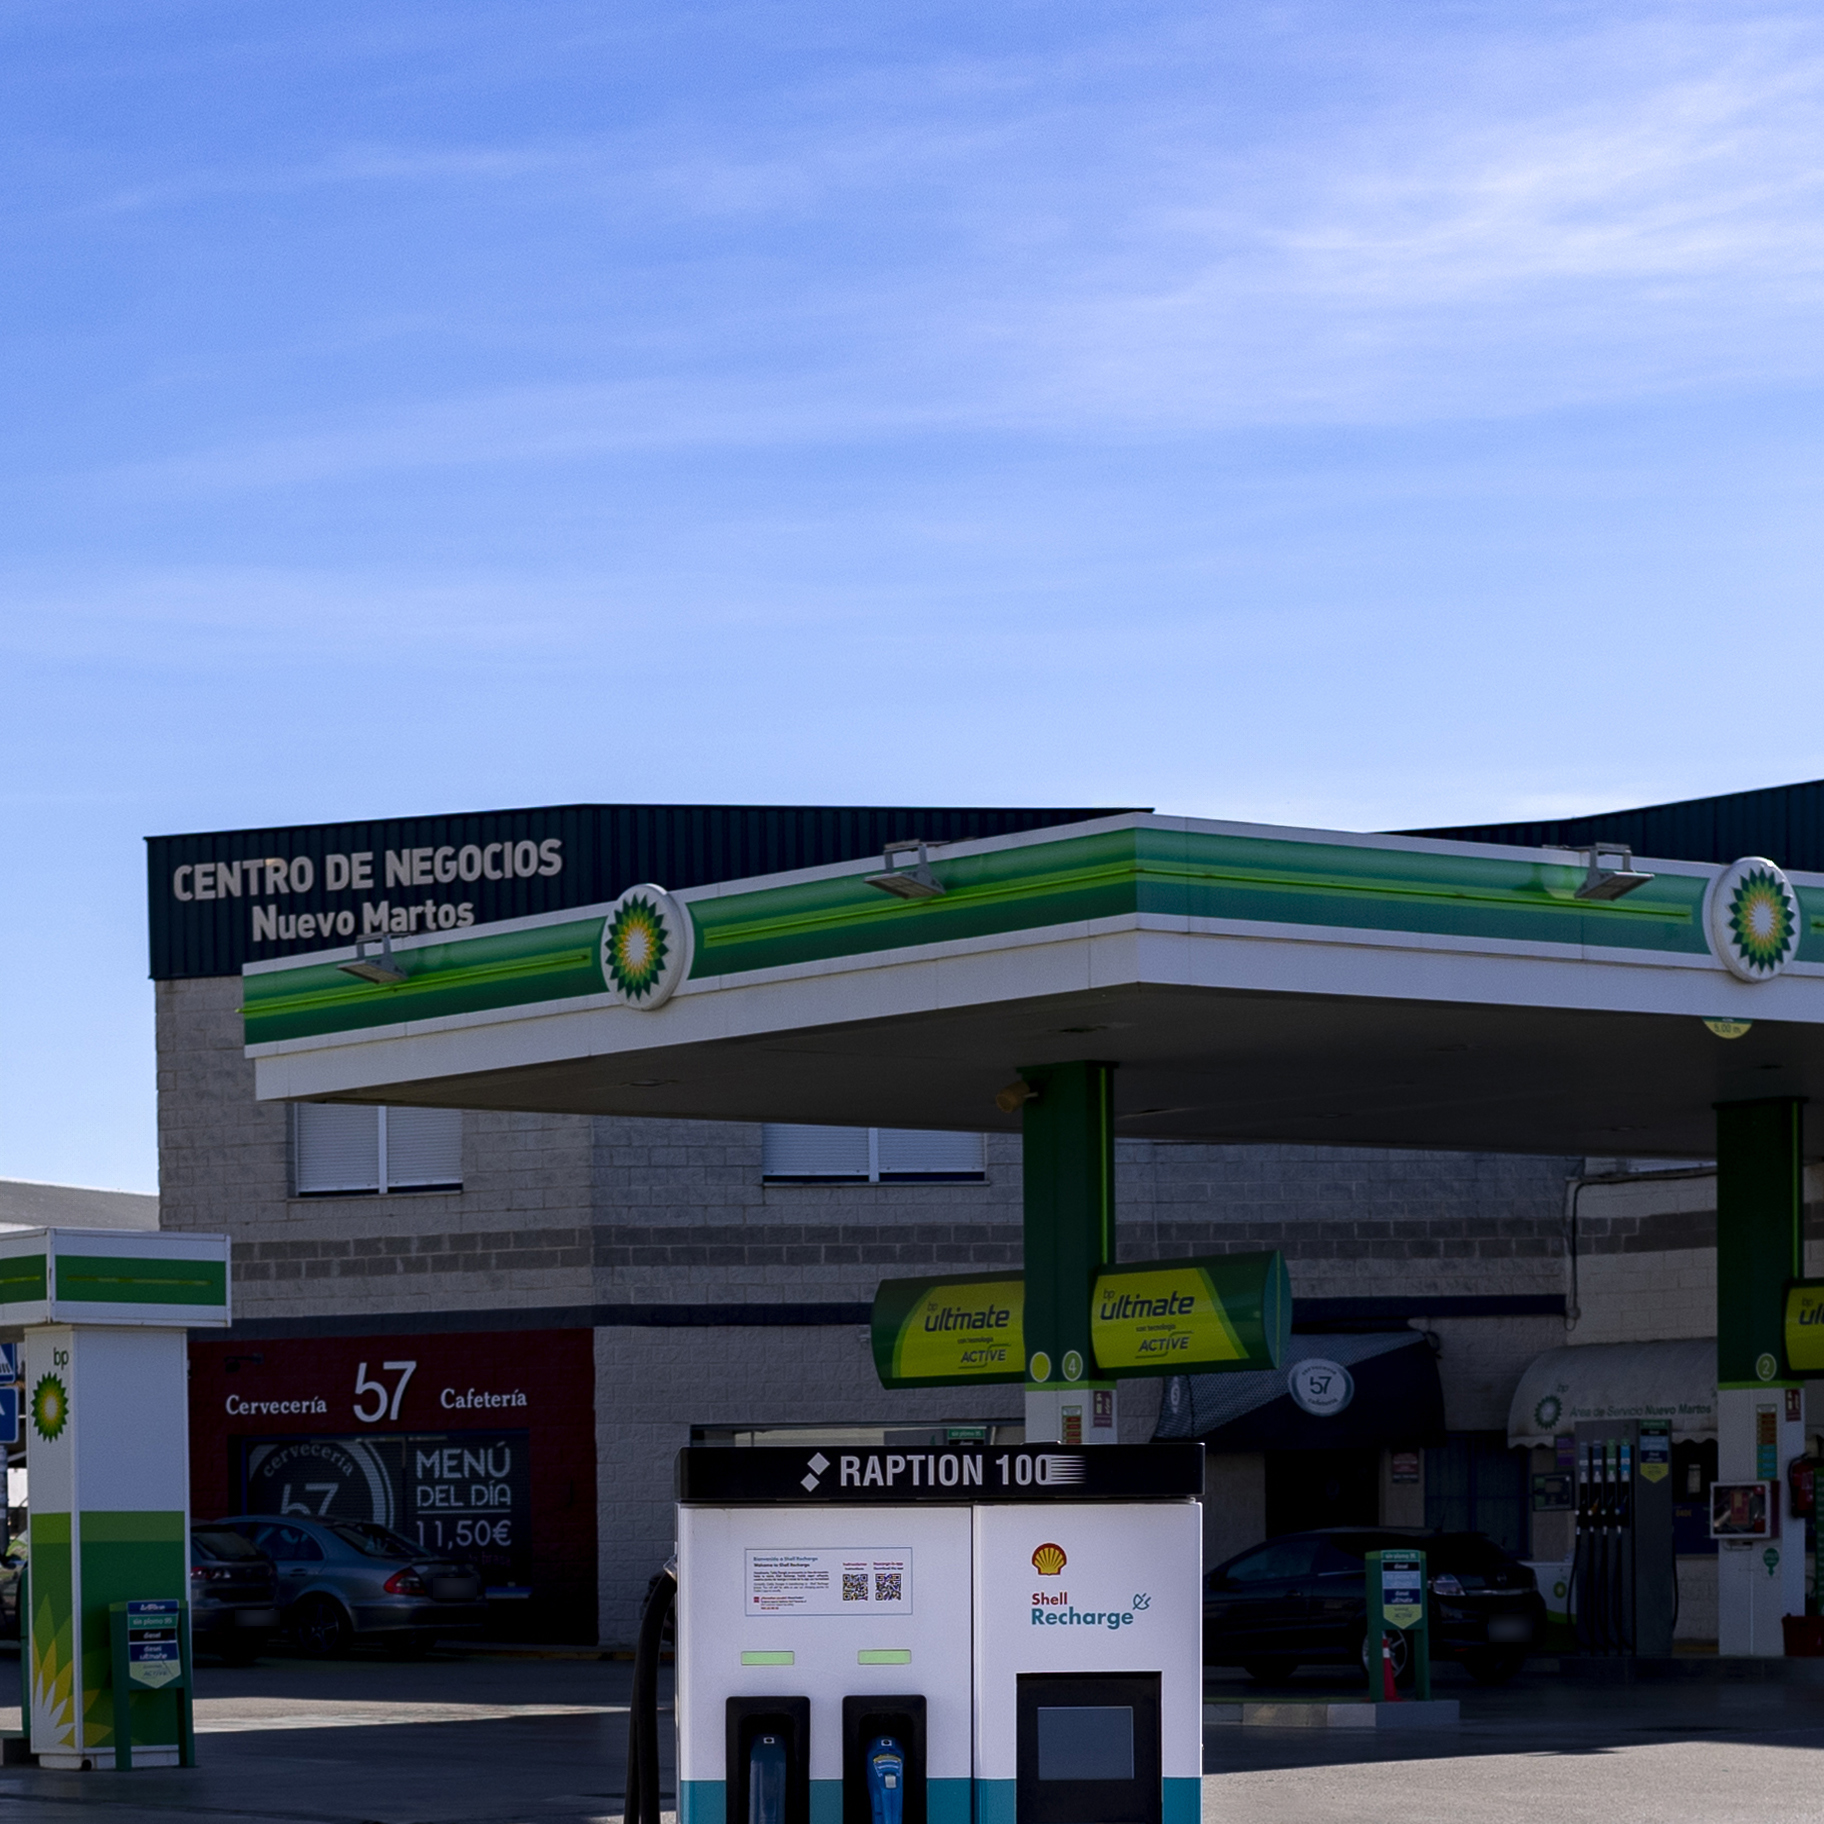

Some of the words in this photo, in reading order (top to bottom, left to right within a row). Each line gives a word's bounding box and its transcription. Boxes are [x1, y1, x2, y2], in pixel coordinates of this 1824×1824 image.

[173, 856, 314, 901] CENTRO
[325, 852, 374, 891] DE
[385, 838, 563, 888] NEGOCIOS
[251, 903, 355, 942] Nuevo
[363, 899, 475, 935] Martos
[925, 1304, 1010, 1332] ultimate
[1100, 1291, 1195, 1321] ultimate
[960, 1347, 1006, 1364] ACTIVE
[1139, 1335, 1190, 1352] ACTIVE
[53, 1347, 70, 1370] bp
[1068, 1357, 1076, 1372] 4
[1762, 1359, 1770, 1372] 2
[353, 1360, 417, 1423] 57
[1310, 1376, 1331, 1395] 57
[226, 1394, 327, 1416] Cervecería
[440, 1388, 527, 1409] Cafetería
[1593, 1407, 1605, 1416] de
[1607, 1405, 1643, 1416] Servicio
[1645, 1404, 1676, 1415] Nuevo
[1678, 1403, 1712, 1415] Martos
[263, 1442, 353, 1478] cervecería
[416, 1440, 511, 1480] MENÚ
[840, 1453, 983, 1487] RAPTION
[996, 1453, 1058, 1487] 100
[416, 1485, 464, 1508] DEL
[470, 1481, 512, 1506] DÍA
[416, 1519, 512, 1551] 11,50€
[1031, 1591, 1068, 1606] Shell
[1031, 1606, 1134, 1630] Recharge
